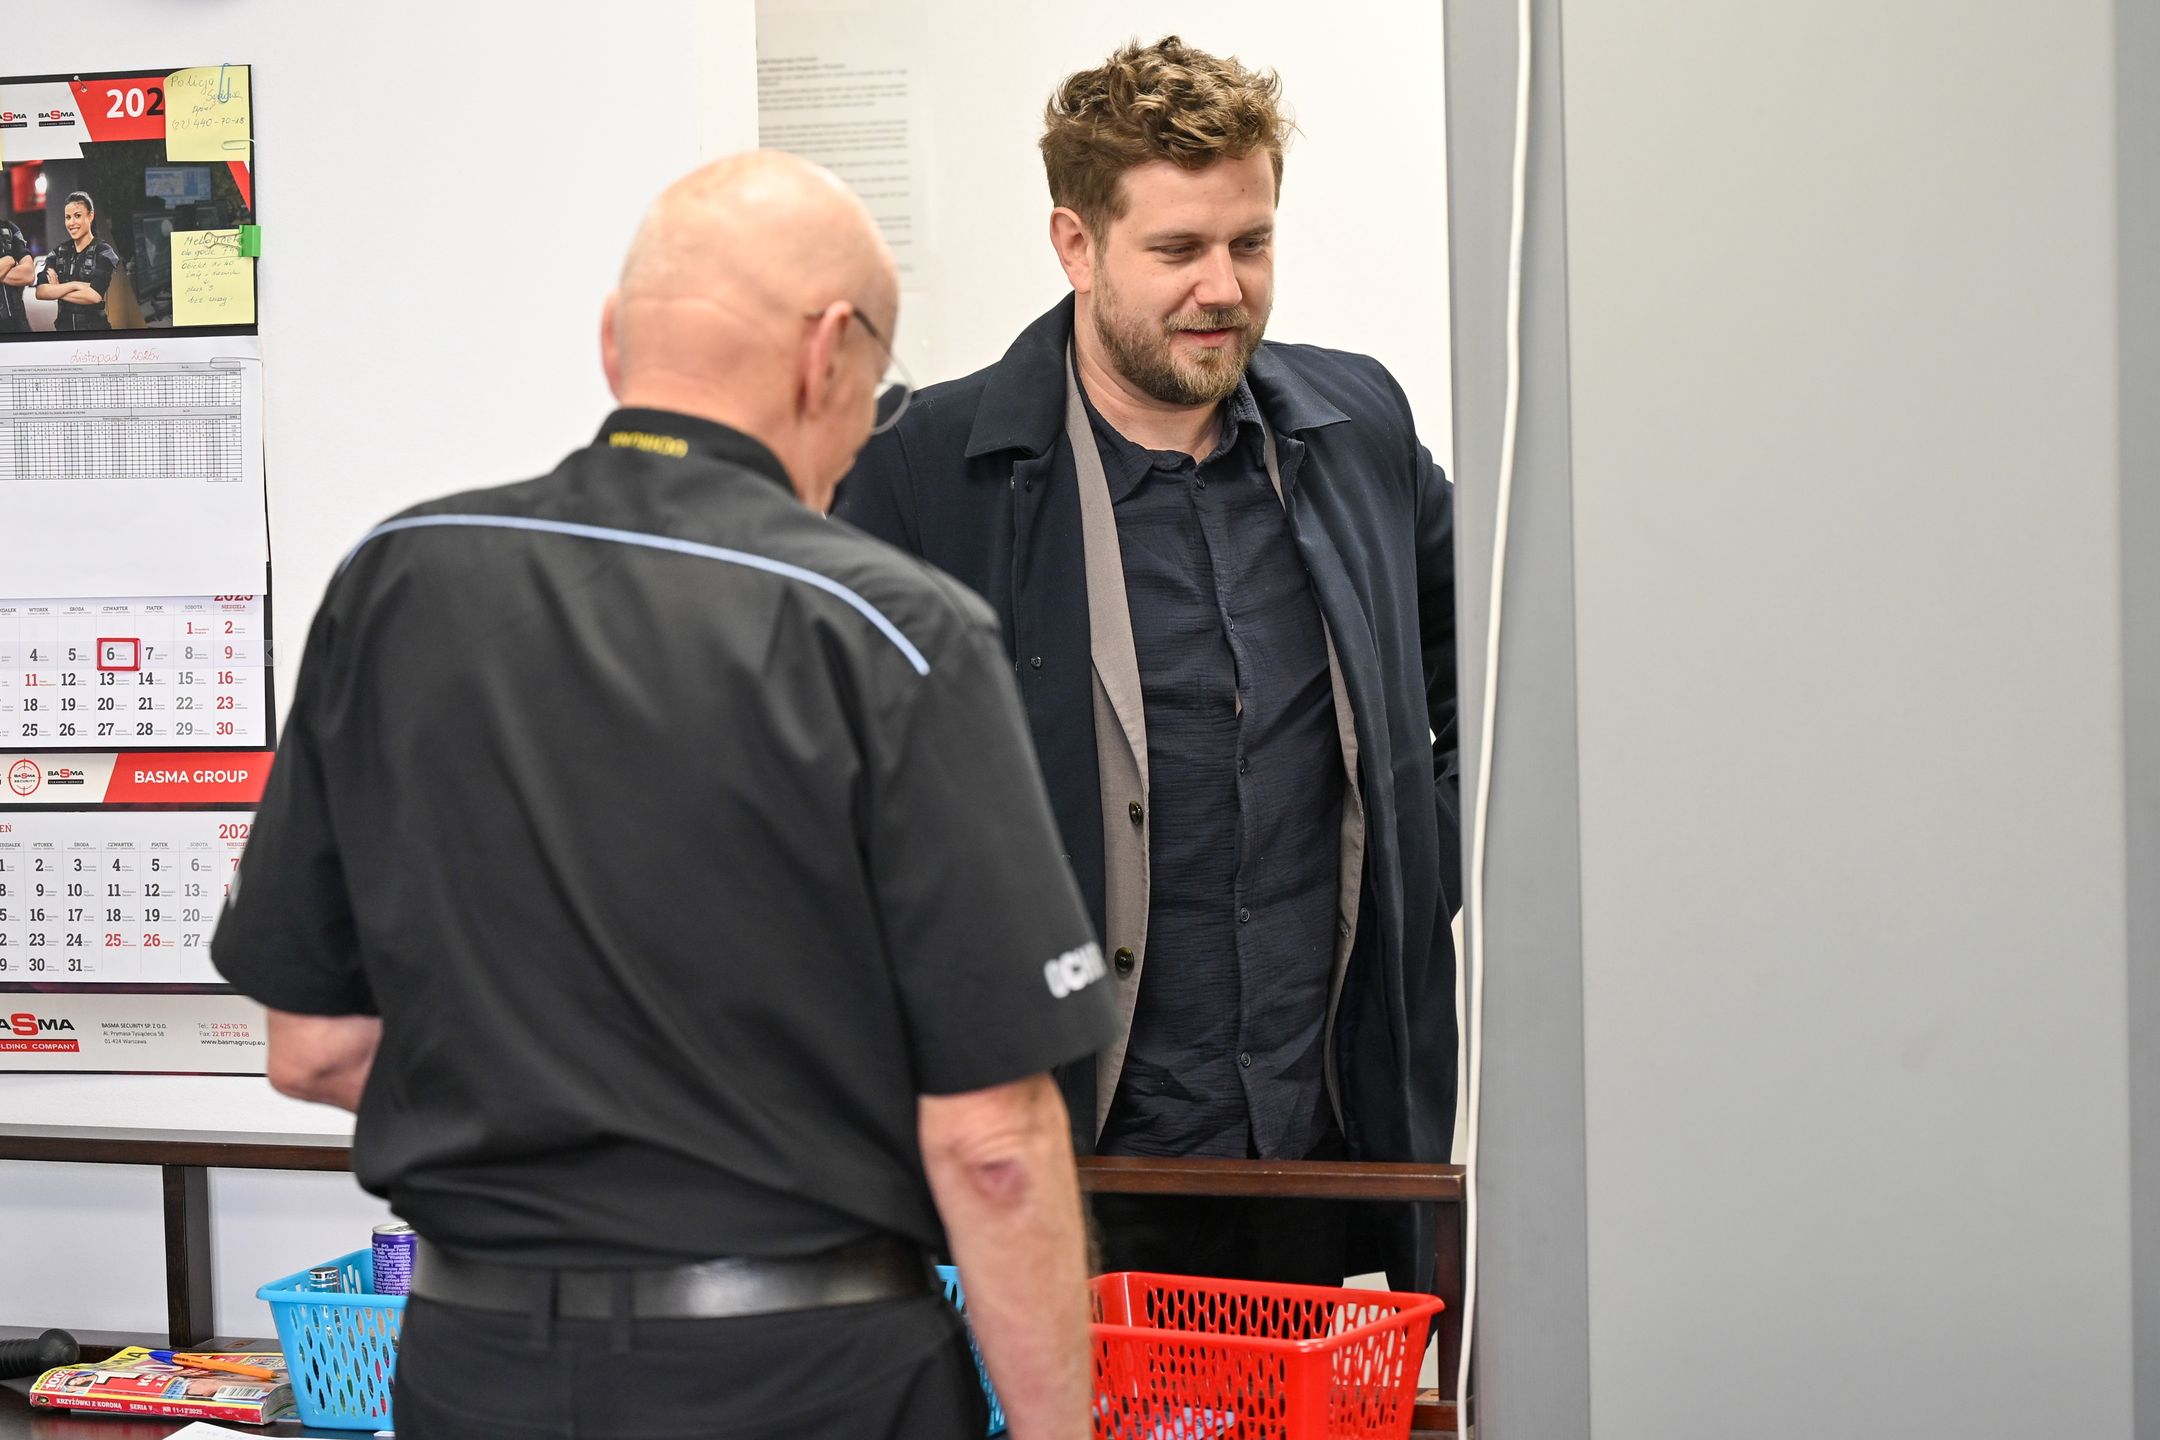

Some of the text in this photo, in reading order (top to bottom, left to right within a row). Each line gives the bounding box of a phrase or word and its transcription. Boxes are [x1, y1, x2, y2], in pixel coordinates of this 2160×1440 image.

[106, 87, 164, 119] 202
[0, 112, 27, 121] SMA
[38, 110, 75, 120] BASMA
[187, 621, 233, 634] 1 2
[30, 646, 233, 662] 4 5 6 7 8 9
[25, 671, 233, 686] 11 12 13 14 15 16
[24, 696, 234, 711] 18 19 20 21 22 23
[22, 722, 234, 737] 25 26 27 28 29 30
[48, 769, 84, 778] BASMA
[134, 770, 248, 783] BASMA GROUP
[0, 822, 12, 832] EŃ
[218, 824, 249, 839] 202
[35, 859, 43, 871] 2
[74, 859, 82, 871] 3
[112, 859, 120, 871] 4
[152, 859, 160, 871] 5
[191, 859, 199, 871] 6
[231, 859, 239, 871] 7
[36, 884, 44, 896] 9
[67, 884, 82, 896] 10
[107, 884, 121, 896] 11
[145, 884, 160, 896] 12
[185, 884, 200, 896] 13
[0, 909, 200, 921] 5 16 17 18 19 20
[0, 934, 200, 946] 2 23 24 25 26 27
[0, 958, 82, 971] 9 30 31
[0, 1014, 75, 1035] ASMA
[56, 1397, 91, 1407] KRZYŻÓWKI
[97, 1401, 122, 1410] KORONĄ
[130, 1403, 147, 1411] SERIA
